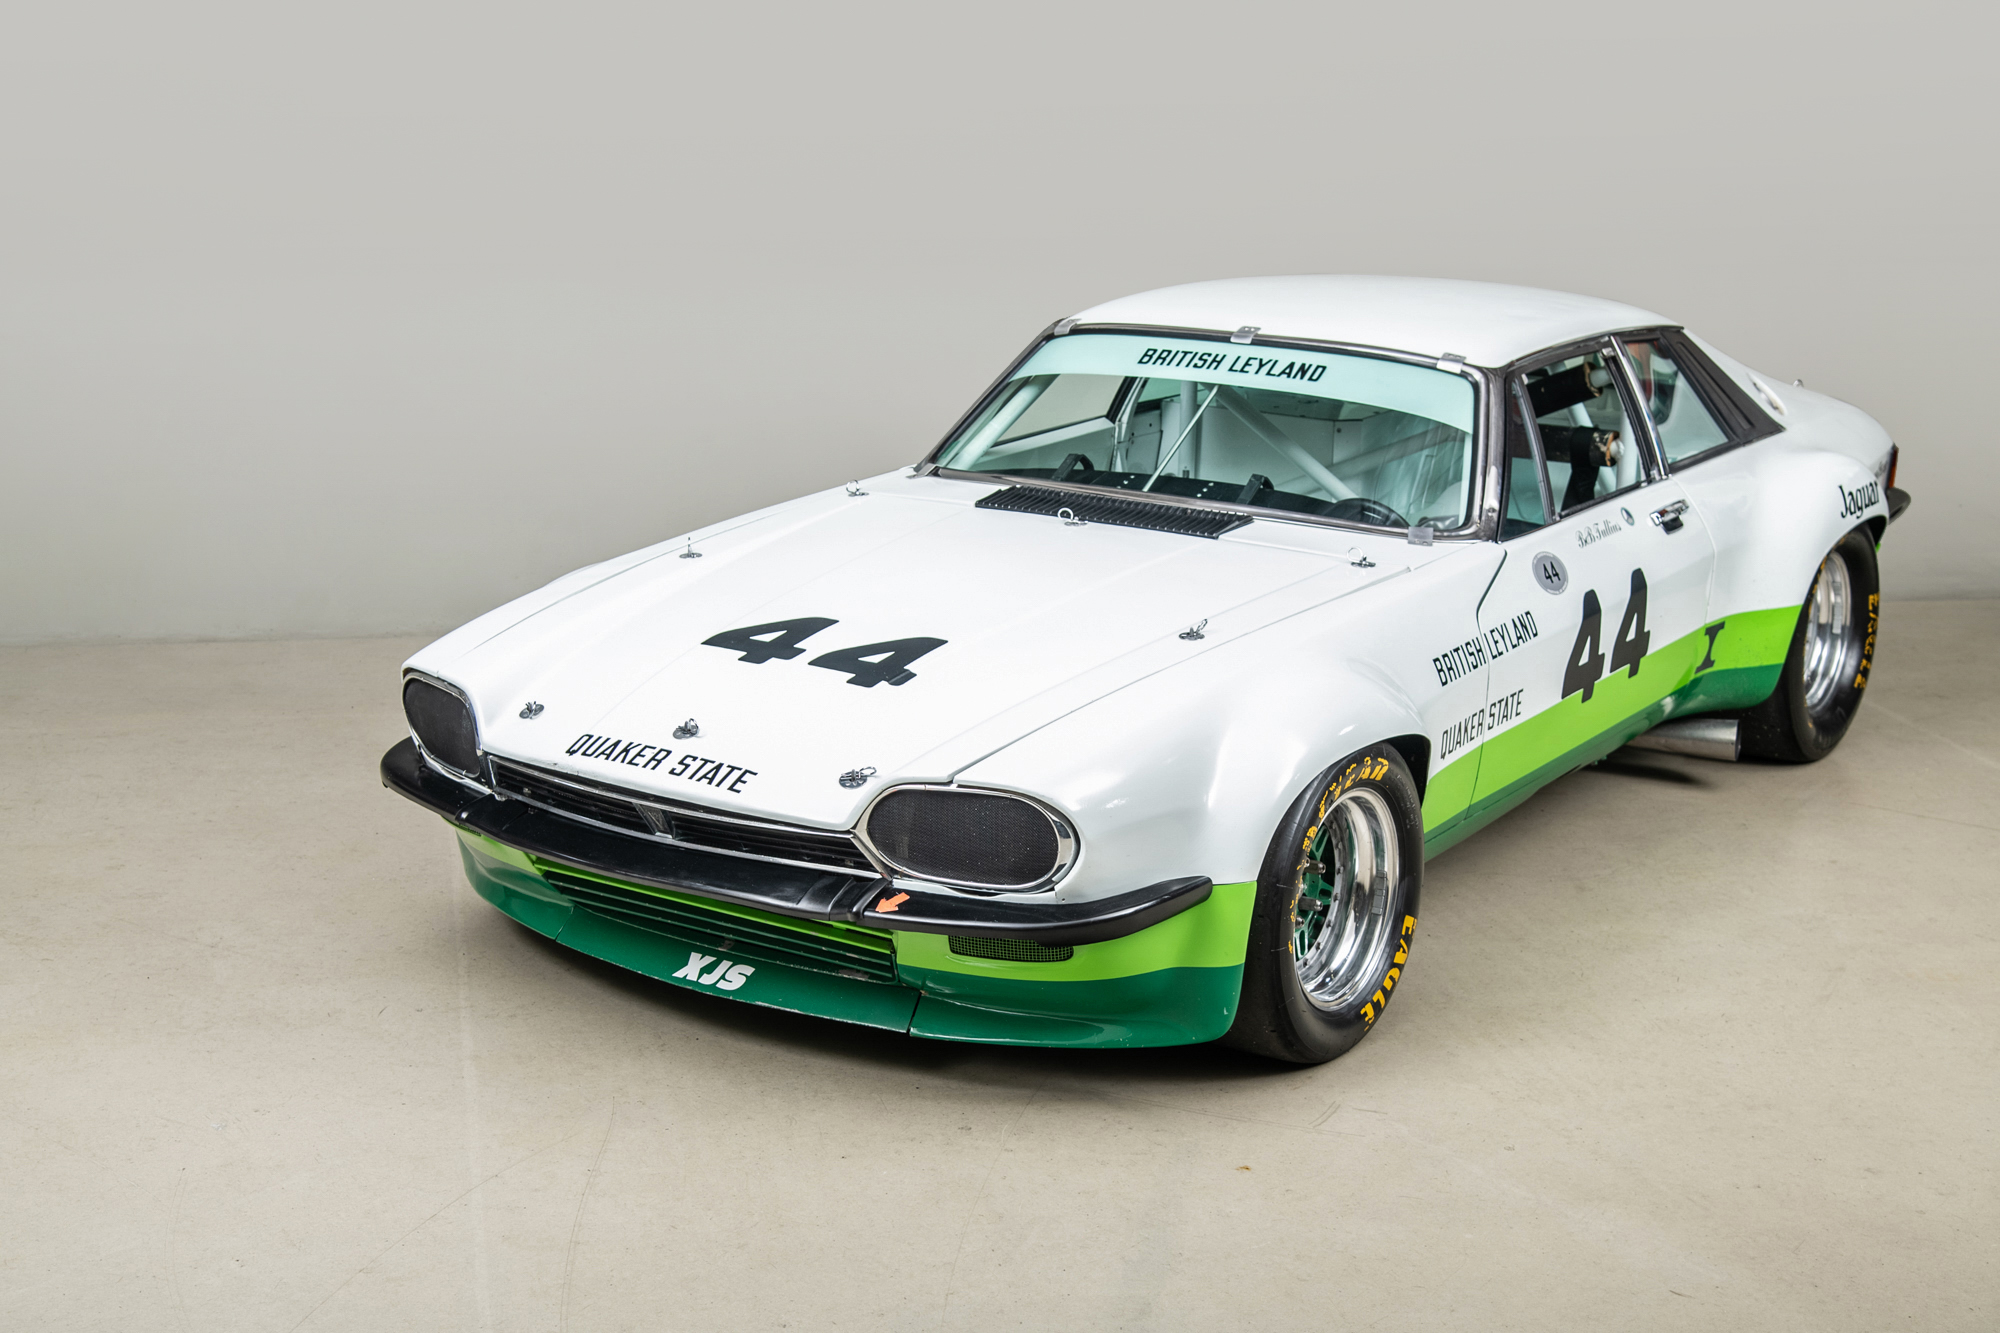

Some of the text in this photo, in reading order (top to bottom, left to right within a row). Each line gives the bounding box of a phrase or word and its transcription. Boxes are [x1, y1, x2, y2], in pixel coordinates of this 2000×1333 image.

[1137, 347, 1327, 382] BRITISH LEYLAND
[1838, 480, 1880, 519] Jaguar
[1543, 560, 1561, 584] 44
[700, 616, 949, 689] 44
[1432, 610, 1539, 687] BRITISH LEYLAND
[1561, 567, 1651, 704] 44
[1440, 688, 1524, 760] QUAKER STATE
[565, 733, 759, 794] QUAKER STATE
[671, 951, 756, 991] XJS
[1360, 914, 1418, 1031] EAGLE
